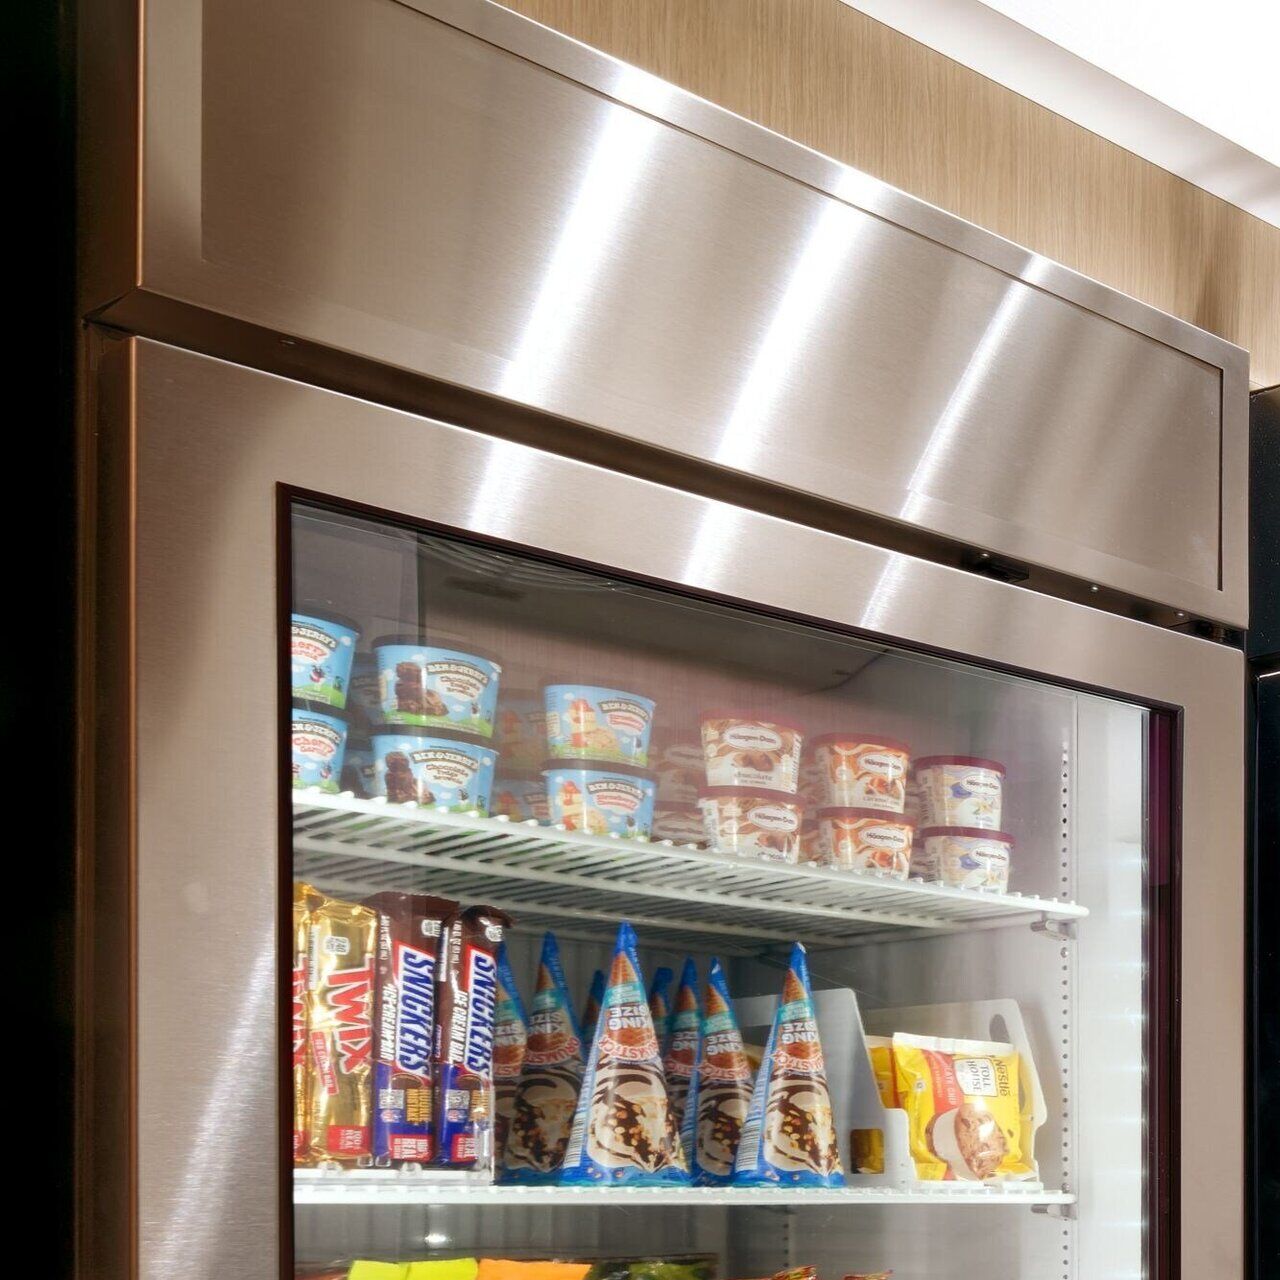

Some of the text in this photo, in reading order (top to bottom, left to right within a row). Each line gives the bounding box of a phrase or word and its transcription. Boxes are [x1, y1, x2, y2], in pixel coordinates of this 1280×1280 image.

[327, 957, 375, 1075] TWIX
[397, 950, 436, 1077] SNICKERS
[465, 955, 497, 1080] SNICKERS
[608, 1017, 650, 1030] KING
[982, 1064, 991, 1087] TOLL
